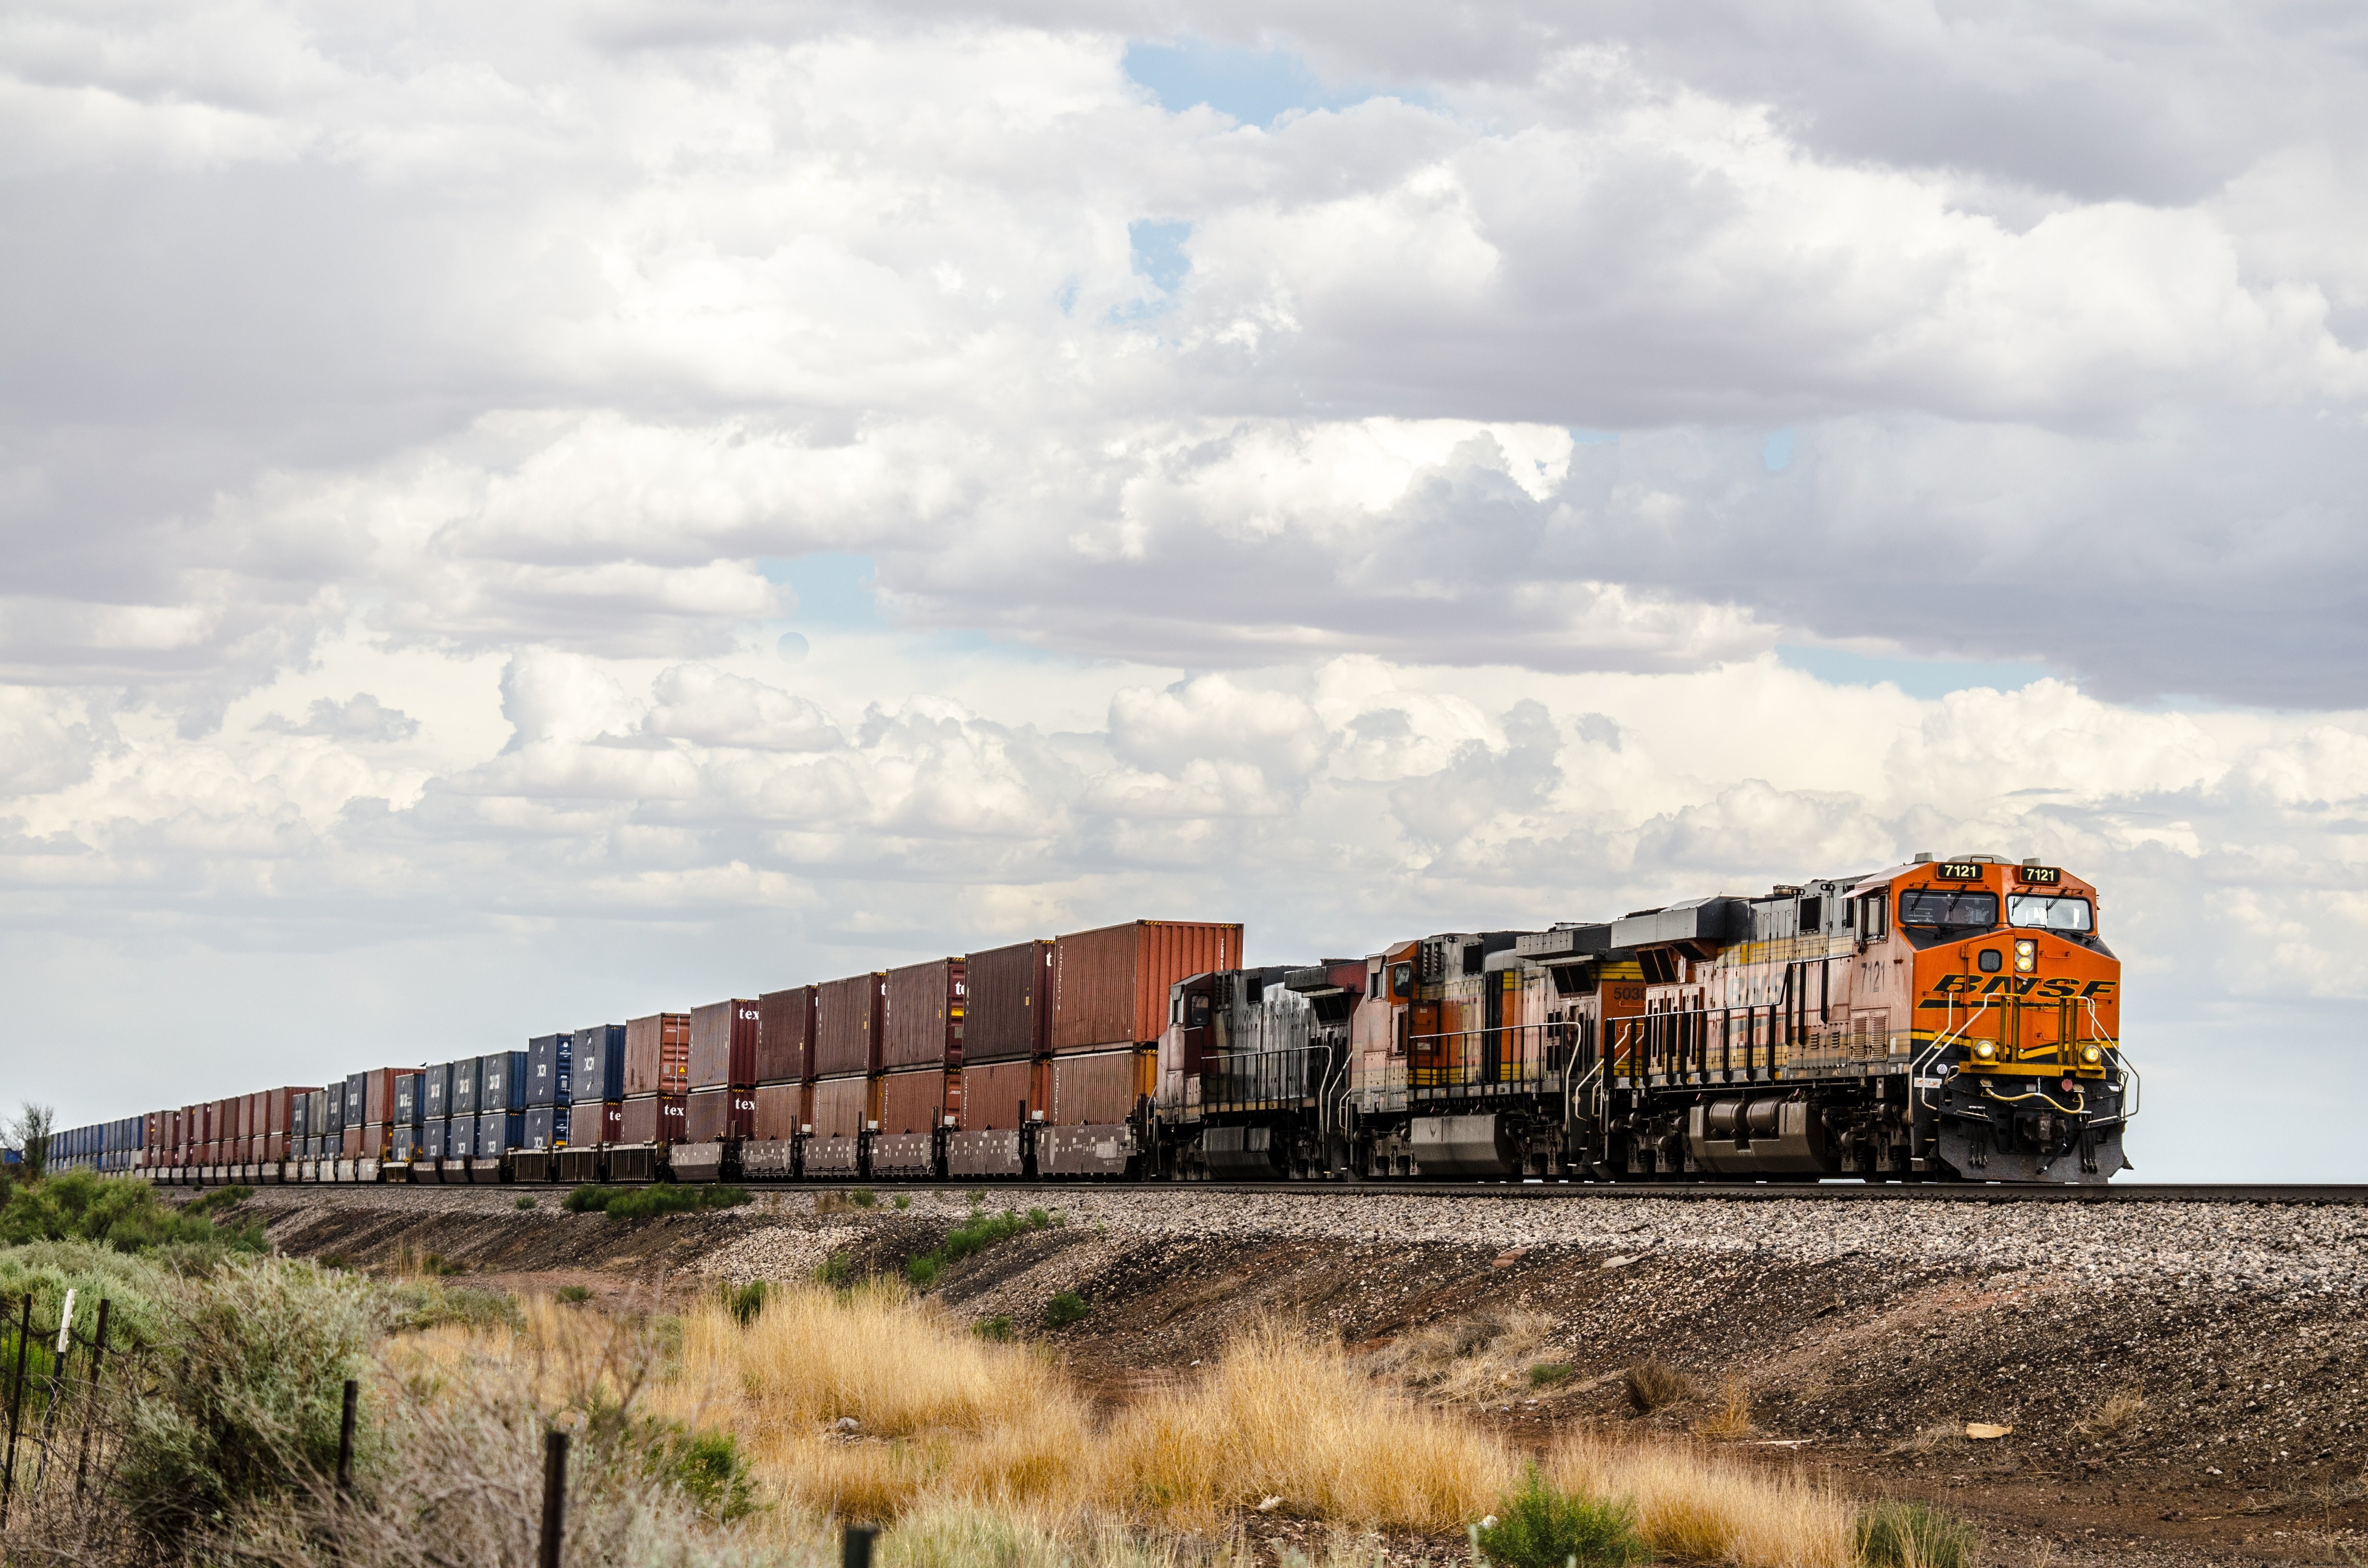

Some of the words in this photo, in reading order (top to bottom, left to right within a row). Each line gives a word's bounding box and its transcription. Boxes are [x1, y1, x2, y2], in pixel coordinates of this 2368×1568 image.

[1945, 865, 1976, 877] 7121
[2026, 869, 2059, 881] 7121
[1861, 960, 1885, 993] 7121
[1931, 974, 2118, 998] BNSF
[739, 1007, 759, 1019] tex
[665, 1104, 684, 1116] tex
[735, 1098, 755, 1110] tex
